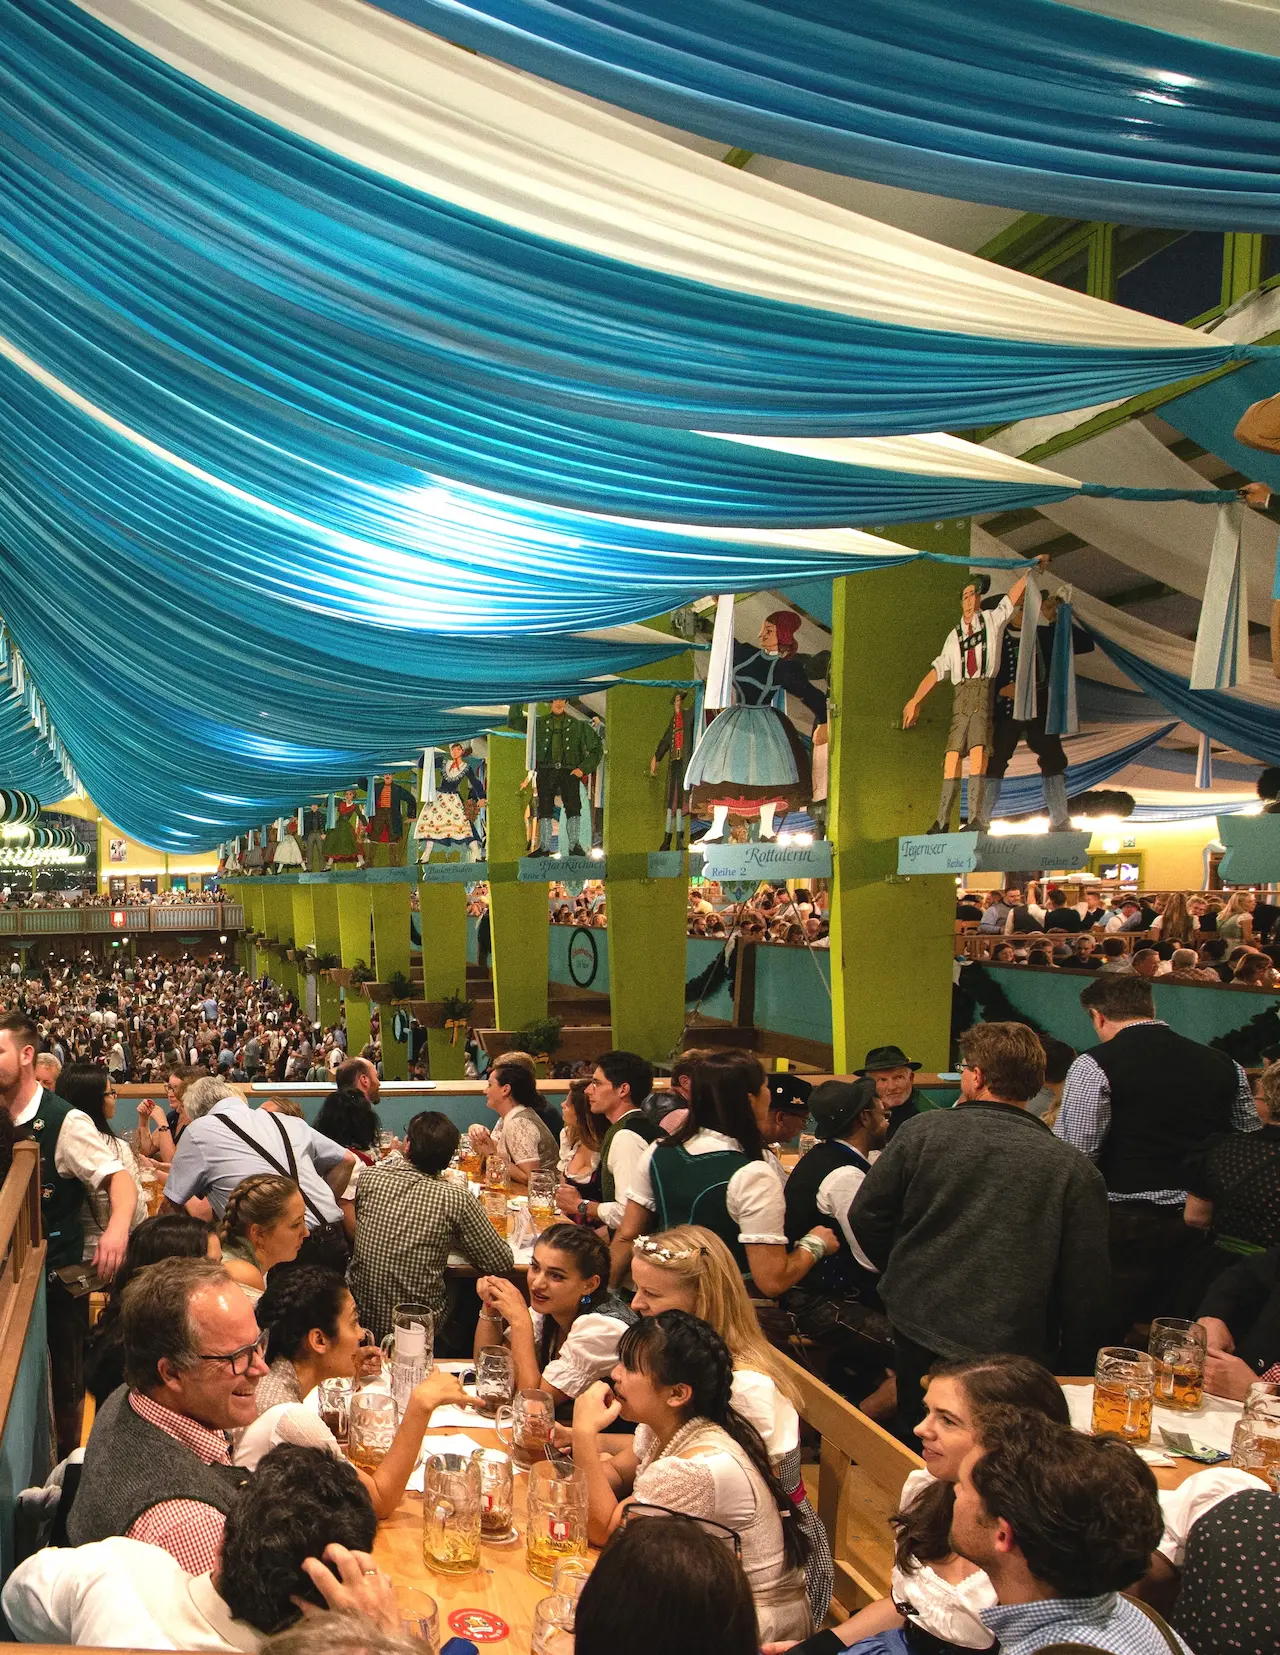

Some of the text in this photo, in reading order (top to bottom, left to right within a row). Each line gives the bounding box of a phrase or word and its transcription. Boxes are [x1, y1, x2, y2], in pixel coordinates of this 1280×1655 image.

[901, 841, 947, 861] Tegernseer
[745, 847, 819, 867] Rottalerin
[966, 857, 972, 868] 1
[1071, 856, 1079, 866] 2
[712, 867, 747, 877] Reihe 2
